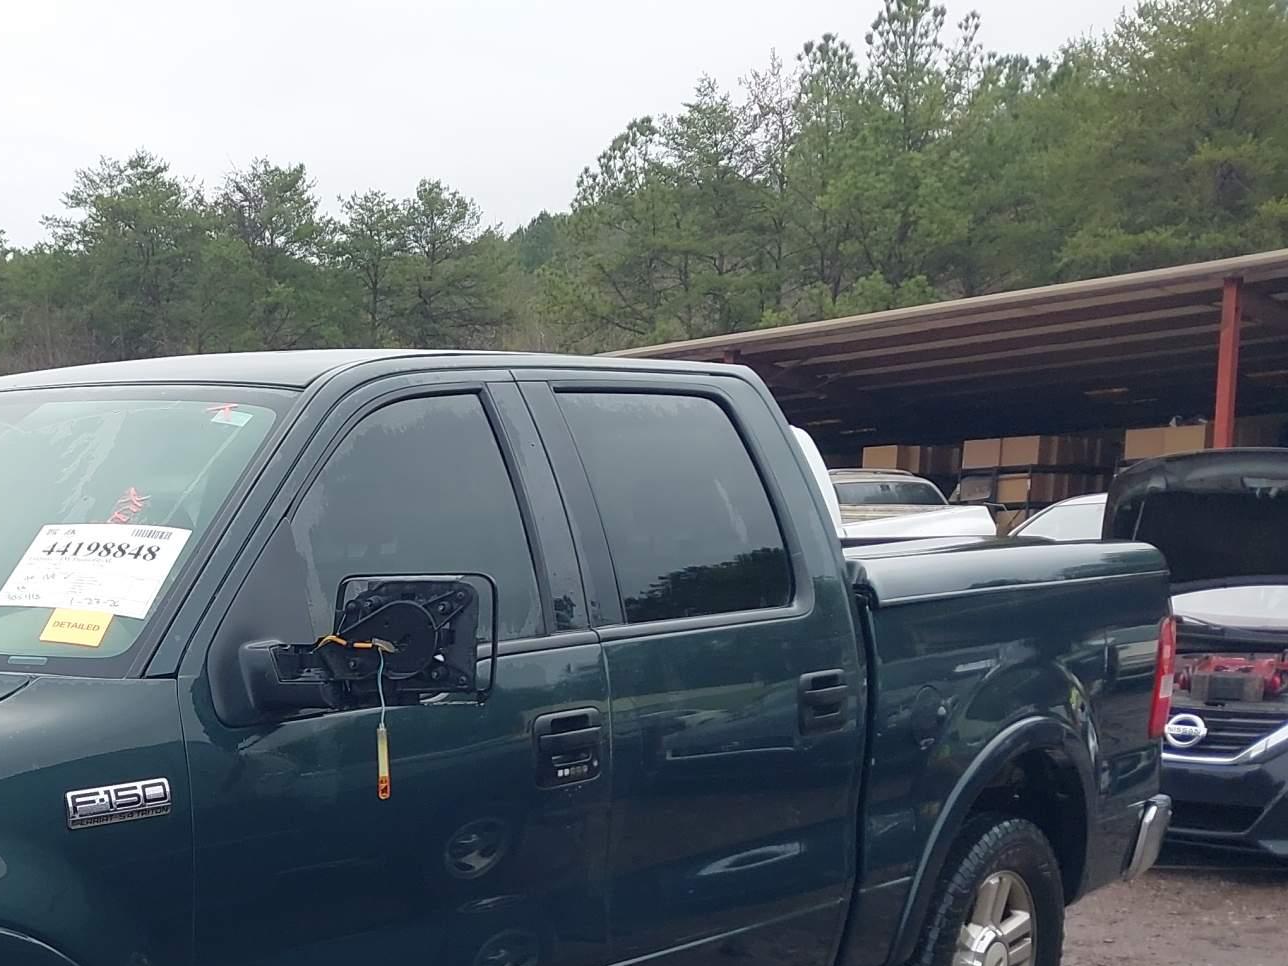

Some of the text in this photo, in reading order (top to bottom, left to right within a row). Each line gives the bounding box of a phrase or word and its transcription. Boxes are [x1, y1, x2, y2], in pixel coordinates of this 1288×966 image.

[42, 540, 161, 562] 44198848
[52, 619, 101, 632] DETAILED
[1167, 726, 1202, 737] NISSAN
[136, 805, 170, 817] TRITON
